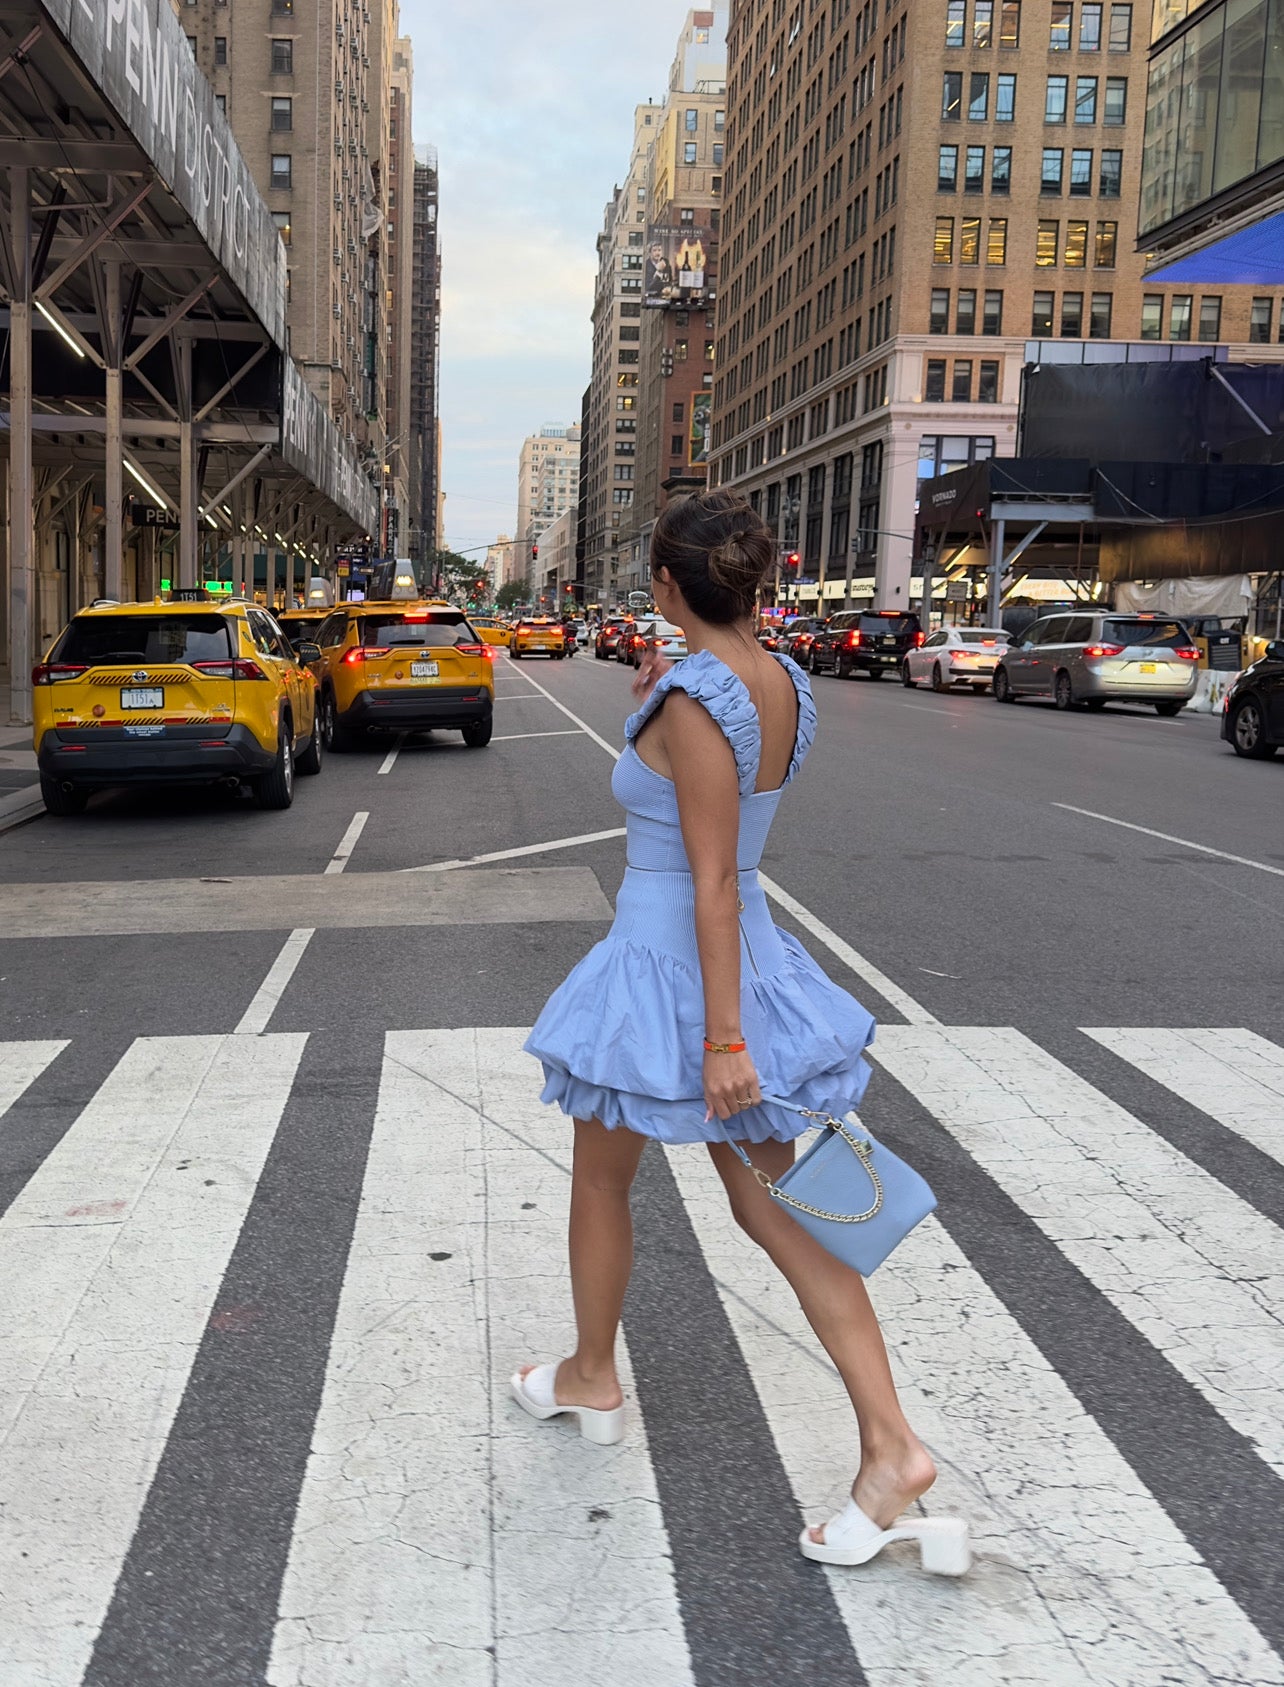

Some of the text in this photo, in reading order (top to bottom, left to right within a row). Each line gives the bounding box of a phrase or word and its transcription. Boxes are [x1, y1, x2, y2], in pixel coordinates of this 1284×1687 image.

[106, 0, 250, 258] PENN DISTRICT
[146, 508, 181, 524] PEN
[180, 593, 197, 602] 1T51
